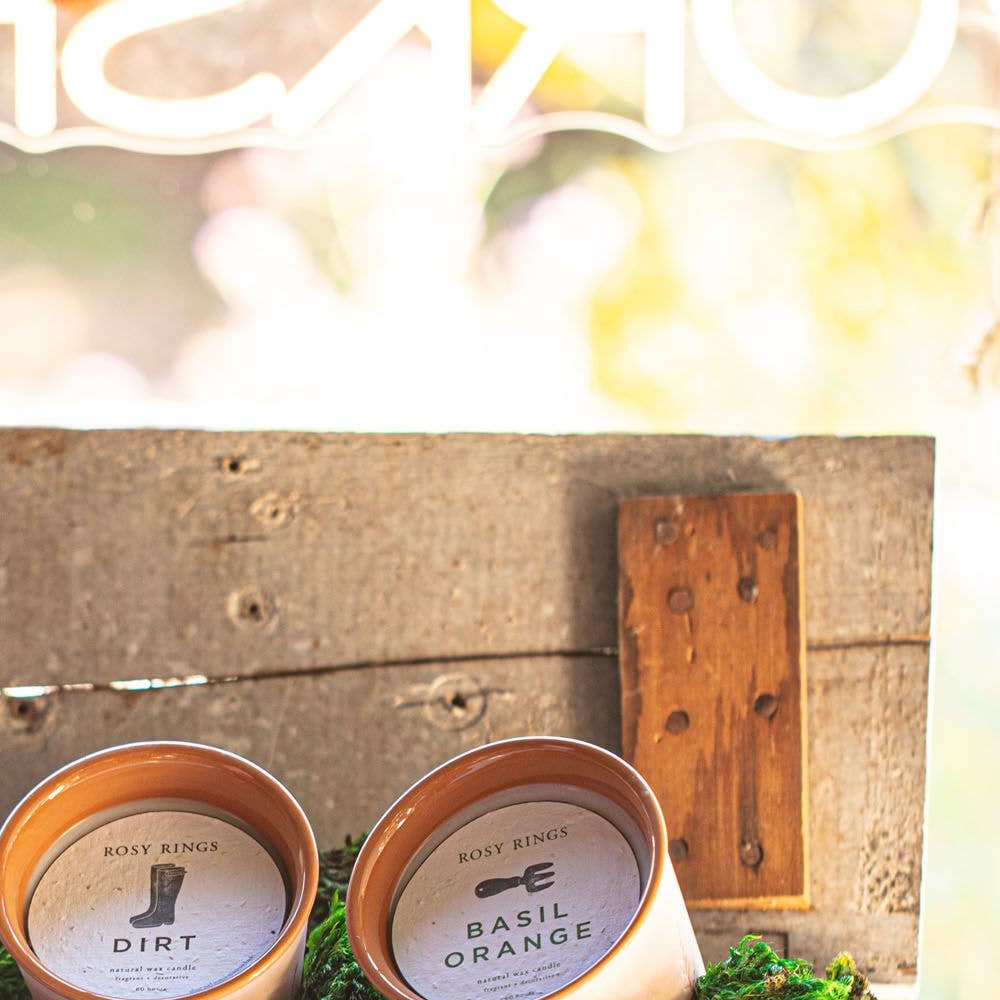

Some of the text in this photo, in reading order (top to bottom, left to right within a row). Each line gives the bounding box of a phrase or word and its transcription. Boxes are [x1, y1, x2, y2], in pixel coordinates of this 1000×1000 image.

[103, 841, 219, 857] ROSY RINGS
[458, 826, 569, 864] ROSY RINGS
[467, 903, 568, 940] BASIL
[113, 935, 197, 953] DIRT
[444, 921, 592, 968] ORANGE
